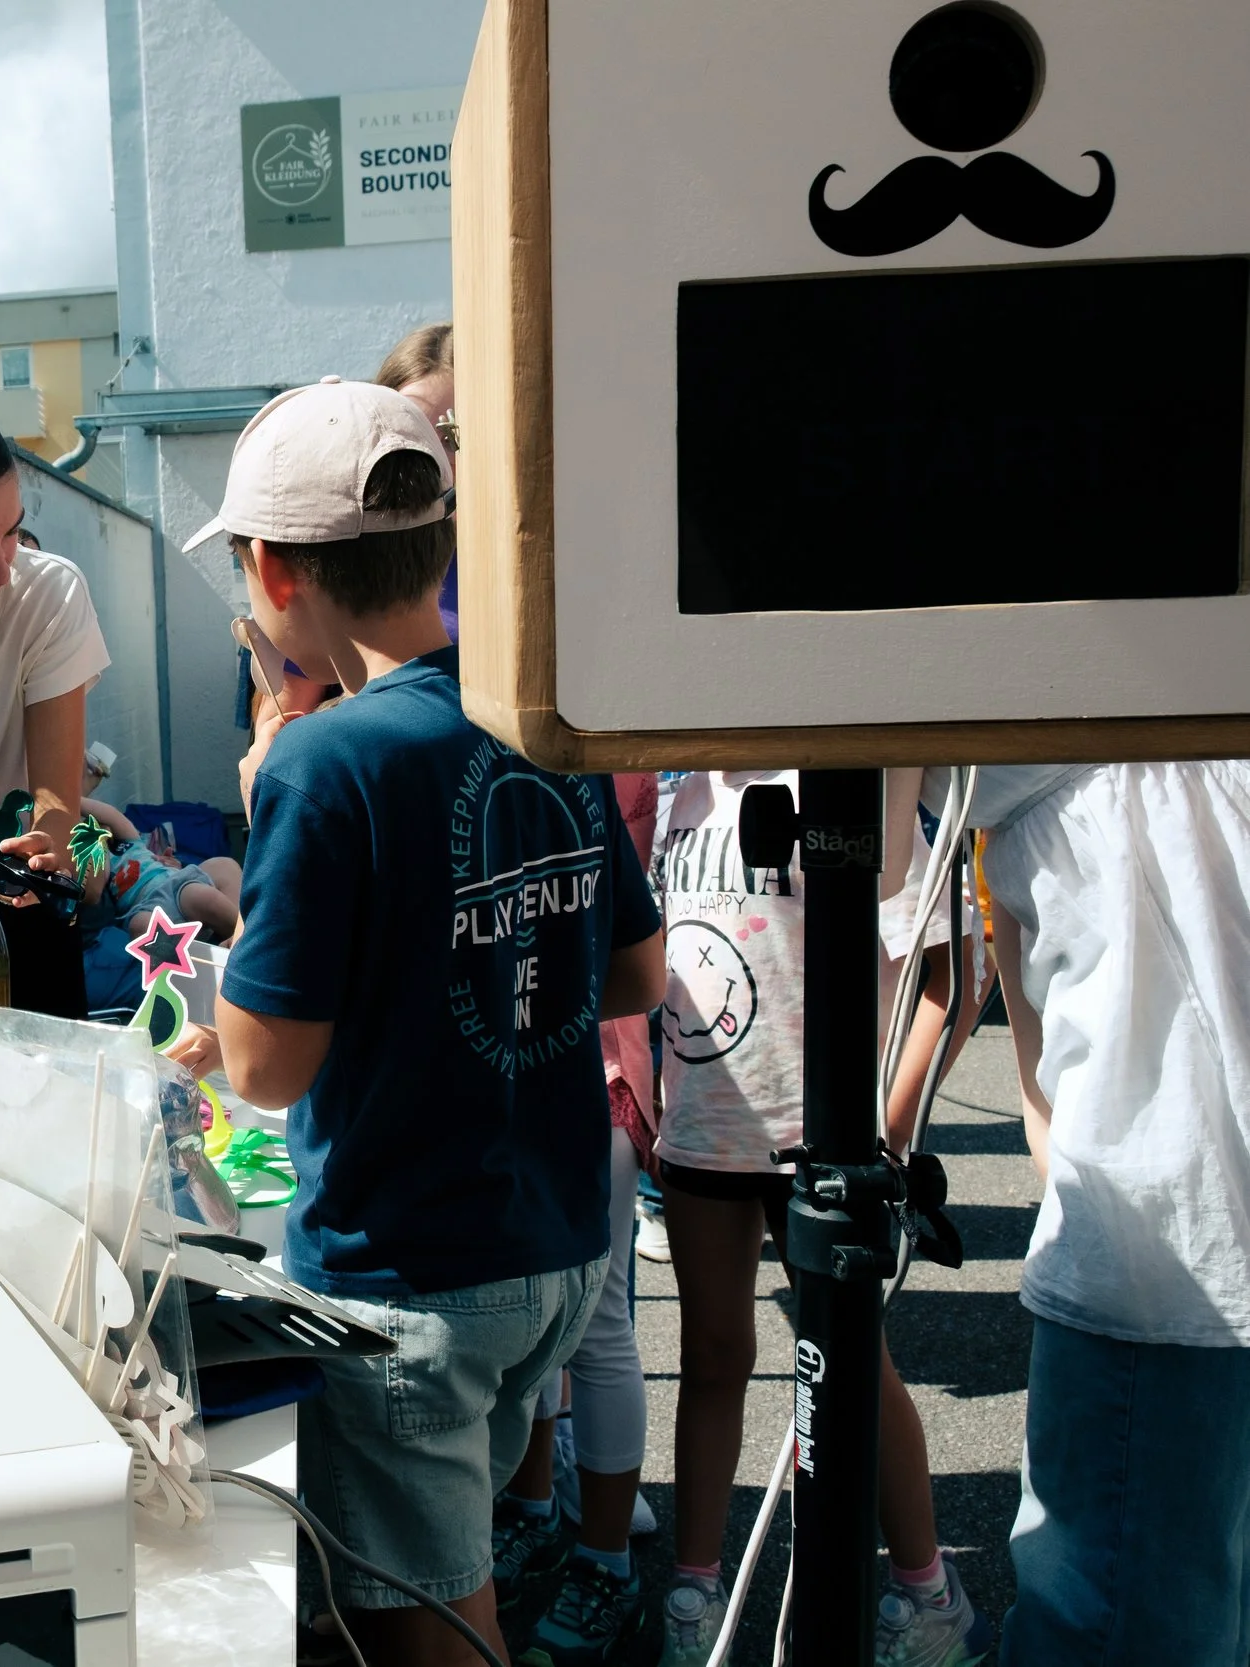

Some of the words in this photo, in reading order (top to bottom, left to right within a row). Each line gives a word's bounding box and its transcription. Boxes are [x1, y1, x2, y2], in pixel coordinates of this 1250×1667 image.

[359, 114, 402, 128] FAIR
[280, 160, 305, 170] FAIR
[360, 143, 452, 168] SECOND
[264, 169, 321, 182] KLEIDUNG
[805, 829, 875, 858] Stagg
[523, 869, 602, 920] ENJOY
[699, 893, 747, 918] HAPPY
[796, 1381, 817, 1436] adam
[795, 1433, 815, 1474] hall
